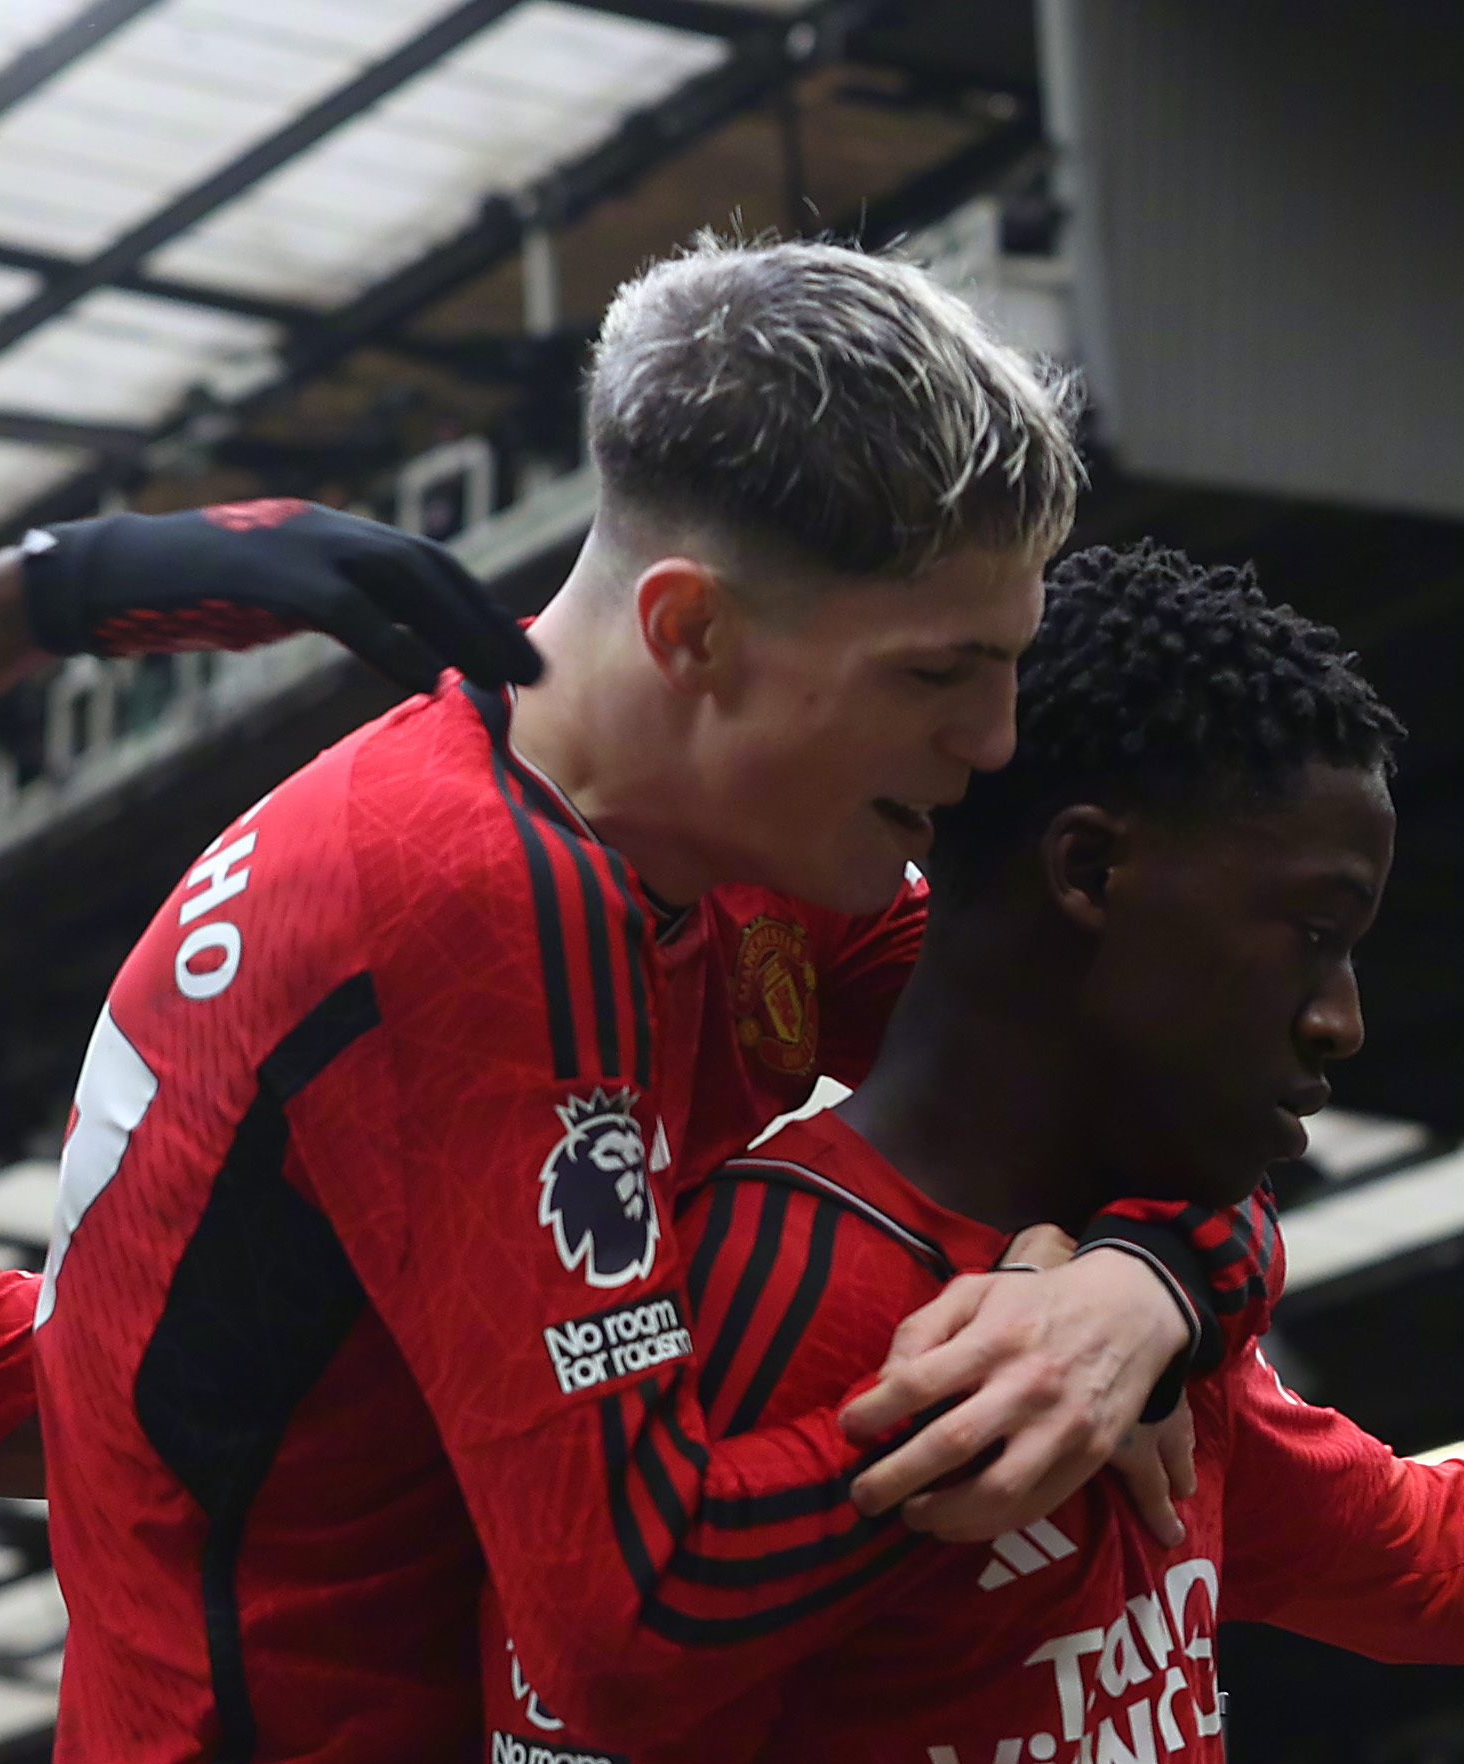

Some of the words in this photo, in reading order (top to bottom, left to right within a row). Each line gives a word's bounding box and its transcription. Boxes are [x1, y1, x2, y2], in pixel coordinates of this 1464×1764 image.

[174, 793, 273, 1001] HO
[543, 1320, 603, 1363] No
[602, 1299, 679, 1346] room
[555, 1350, 609, 1394] for
[610, 1327, 694, 1376] racism
